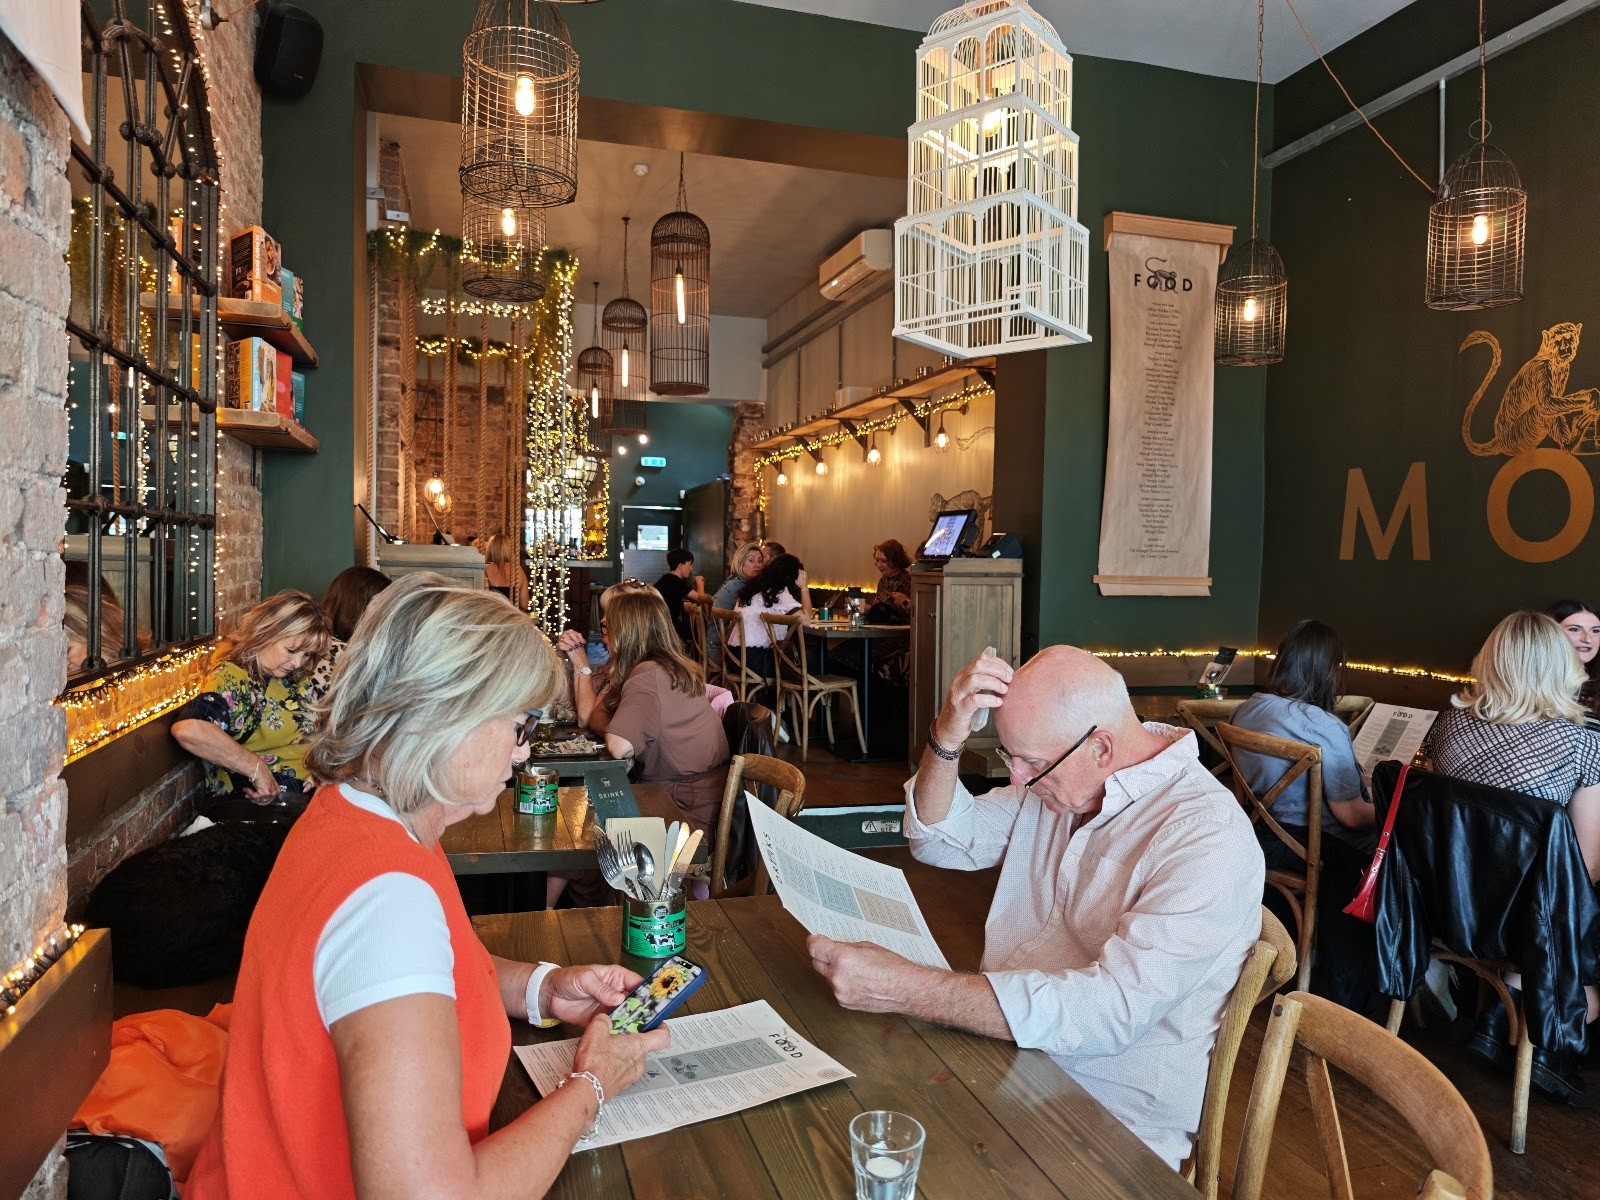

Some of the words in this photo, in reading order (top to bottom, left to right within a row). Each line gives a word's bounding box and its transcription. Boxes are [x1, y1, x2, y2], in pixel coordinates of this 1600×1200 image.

[1134, 273, 1193, 292] FOOD
[1393, 711, 1413, 719] FOOD
[599, 790, 624, 799] DRINKS
[768, 1033, 803, 1058] FOOD
